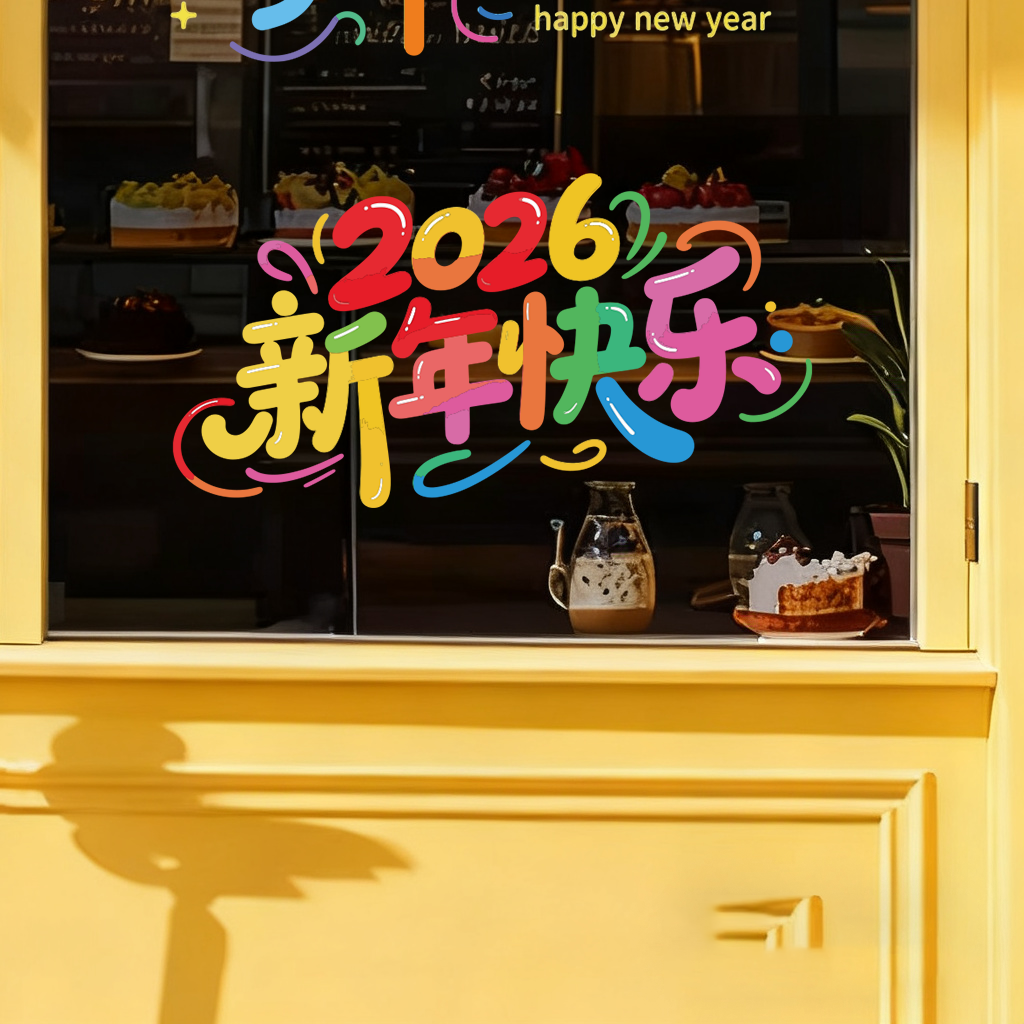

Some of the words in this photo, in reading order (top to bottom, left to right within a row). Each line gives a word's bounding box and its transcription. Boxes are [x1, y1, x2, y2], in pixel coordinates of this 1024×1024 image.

[534, 4, 625, 38] happy
[635, 11, 697, 31] new
[705, 11, 772, 38] year
[328, 172, 621, 311] 2026
[201, 246, 782, 509] 新年快乐
